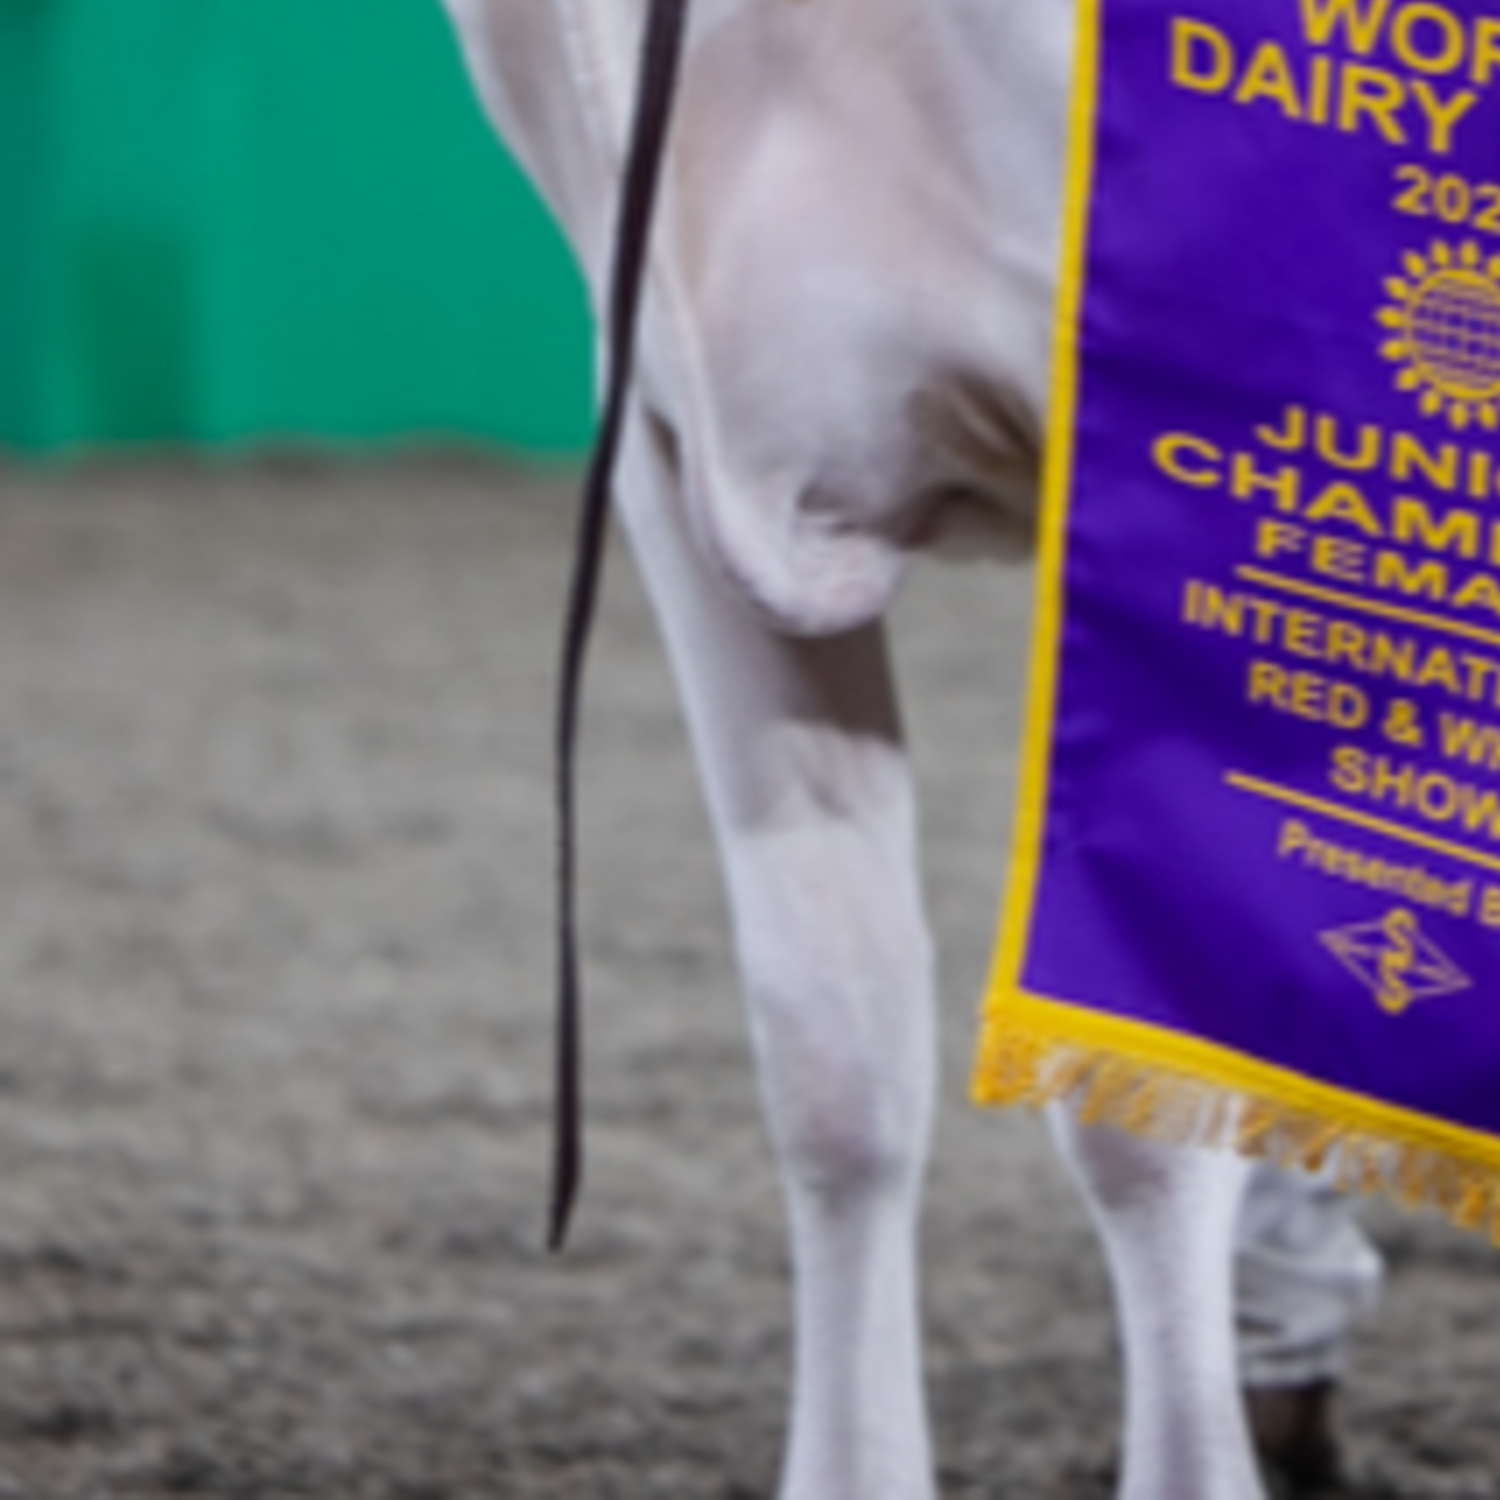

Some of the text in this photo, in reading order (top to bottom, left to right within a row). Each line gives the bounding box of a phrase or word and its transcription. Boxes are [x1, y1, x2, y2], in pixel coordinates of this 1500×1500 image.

[1170, 16, 1478, 155] DAIRY
[1247, 659, 1369, 730] RED
[1382, 697, 1423, 746] &
[1278, 819, 1472, 917] Presented
